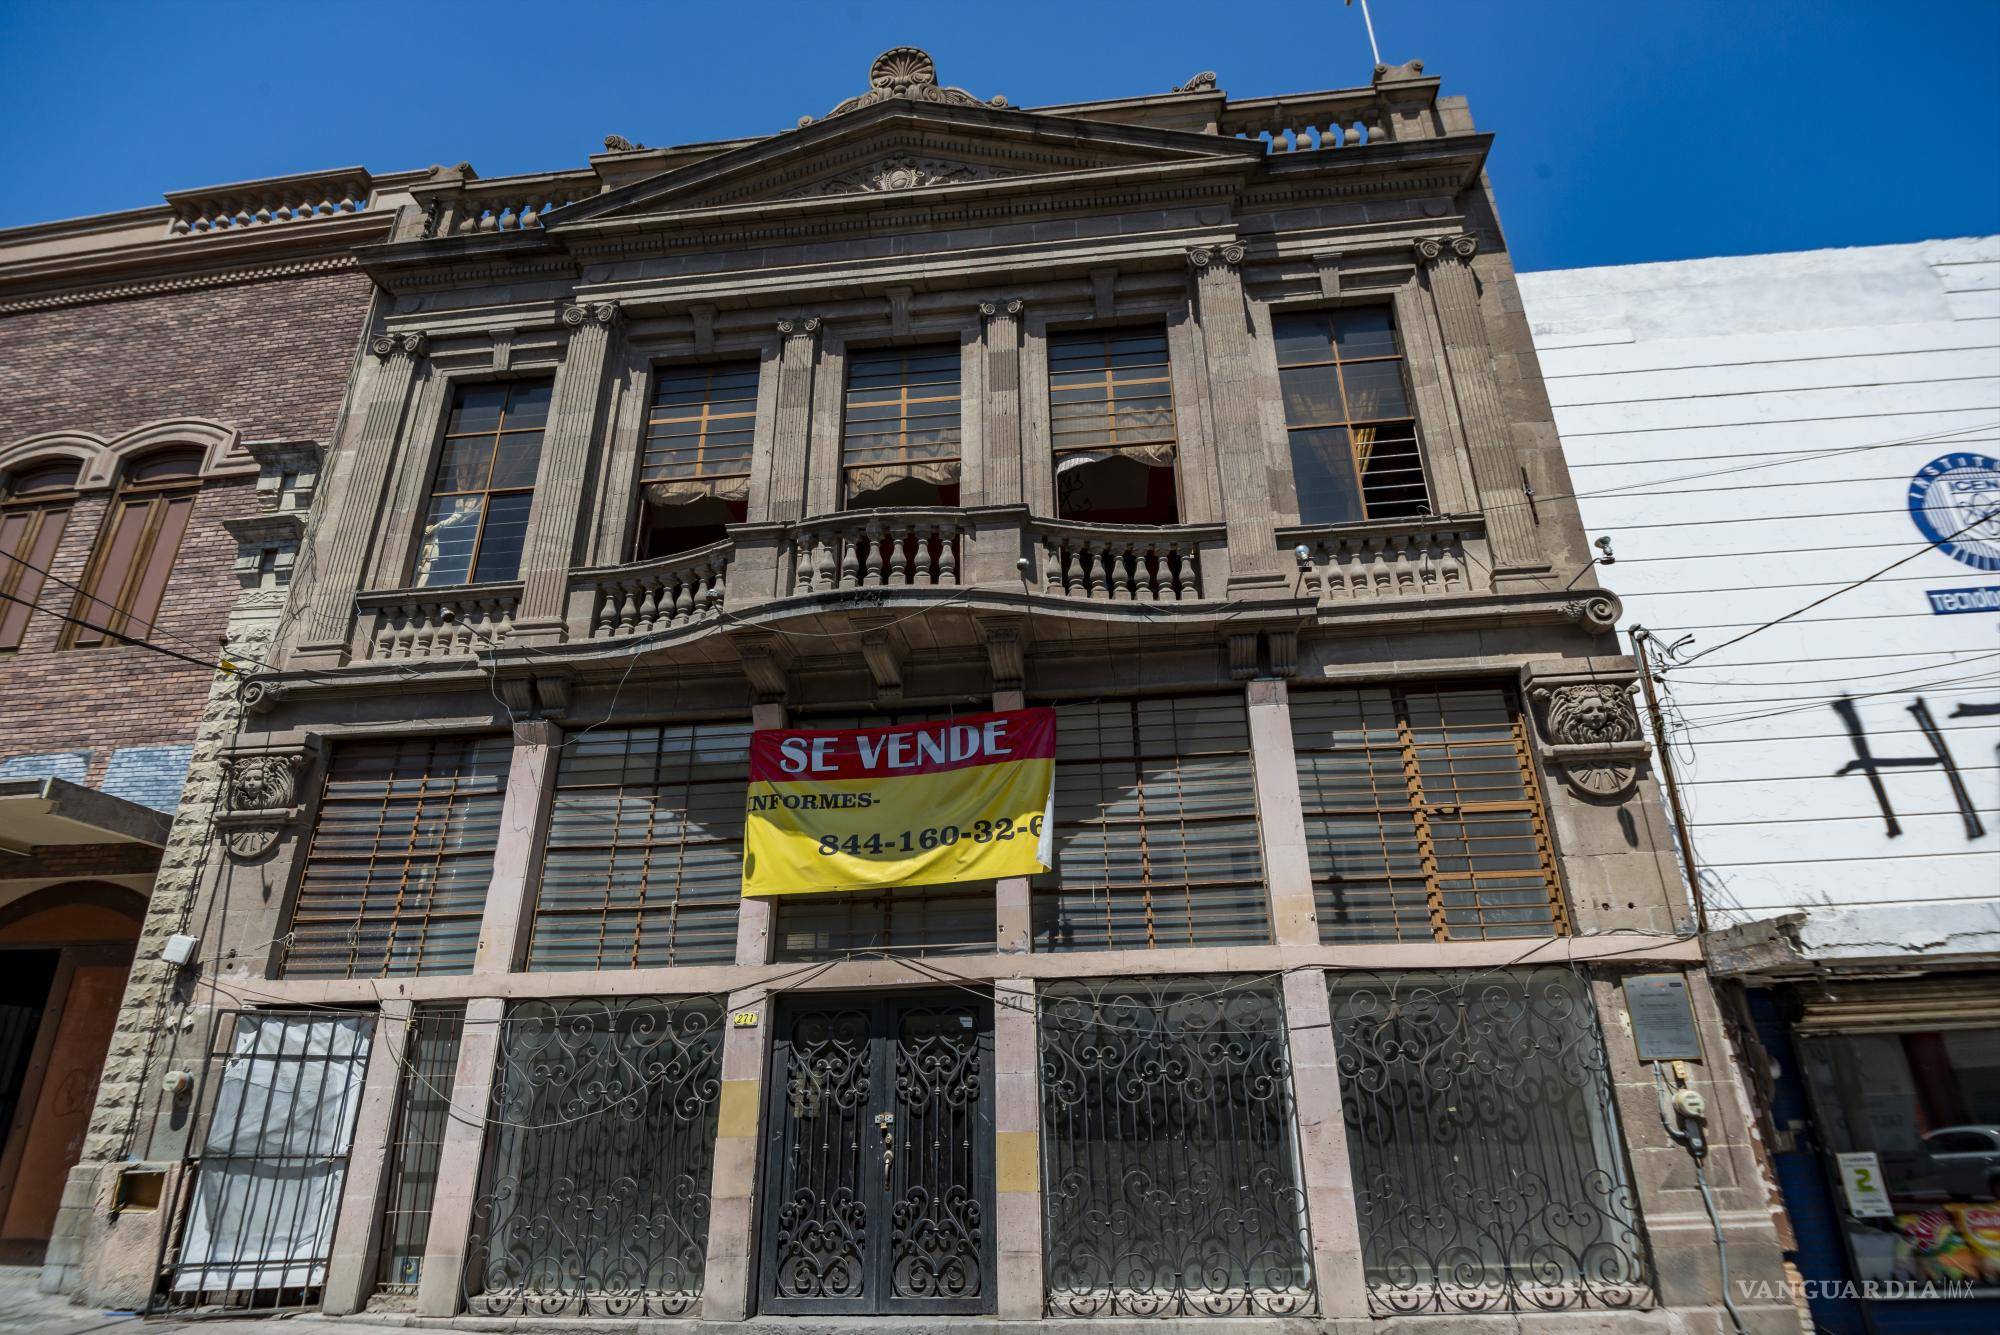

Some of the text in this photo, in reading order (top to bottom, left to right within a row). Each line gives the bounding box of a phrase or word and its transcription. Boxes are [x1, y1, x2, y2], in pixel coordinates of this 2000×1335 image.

[780, 720, 1012, 773] SE VENDE
[737, 1013, 754, 1024] 271
